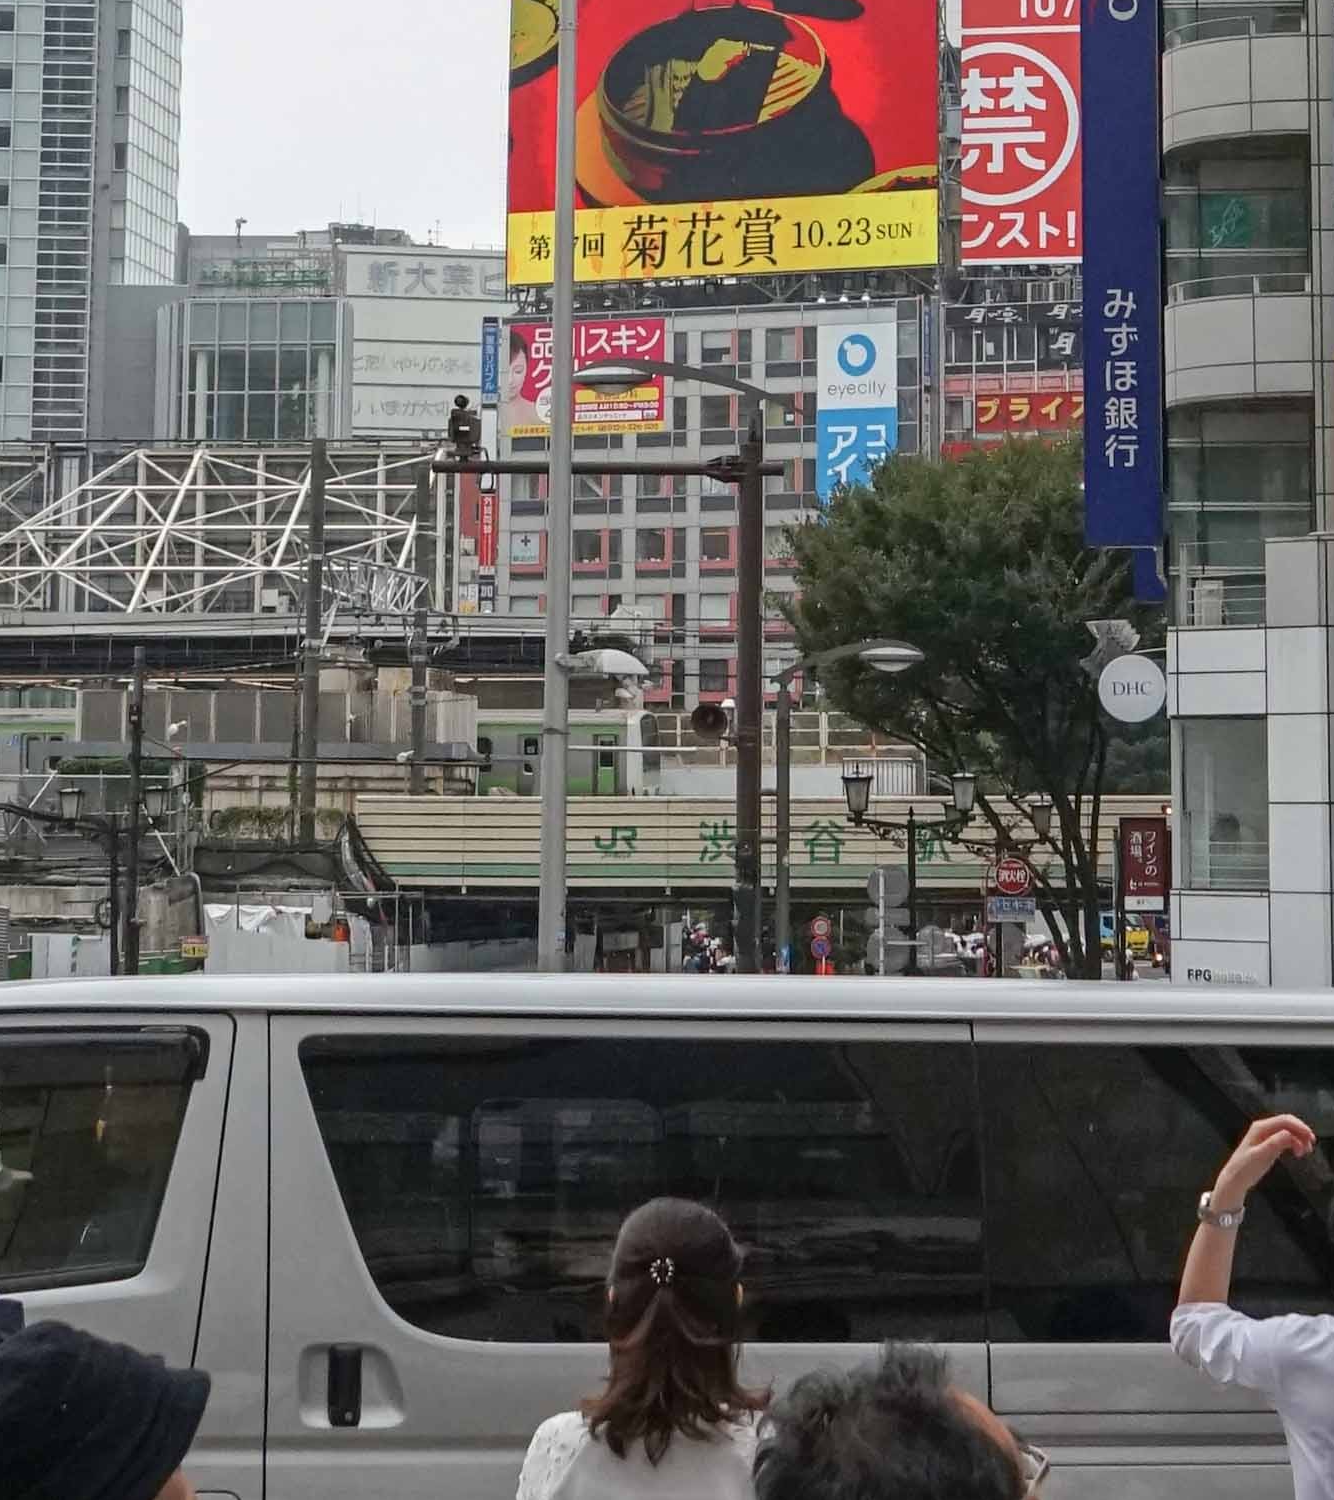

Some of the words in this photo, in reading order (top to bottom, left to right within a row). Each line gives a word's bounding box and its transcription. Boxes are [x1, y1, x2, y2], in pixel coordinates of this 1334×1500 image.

[961, 66, 1047, 174] 禁
[621, 207, 782, 269] 菊花賞
[791, 217, 872, 249] 10.23
[876, 221, 913, 240] SUN
[827, 380, 887, 397] eyecity
[1103, 288, 1139, 468] みずほ銀行
[1112, 681, 1153, 696] DHC
[594, 825, 637, 850] JR
[1145, 830, 1158, 877] ワインの
